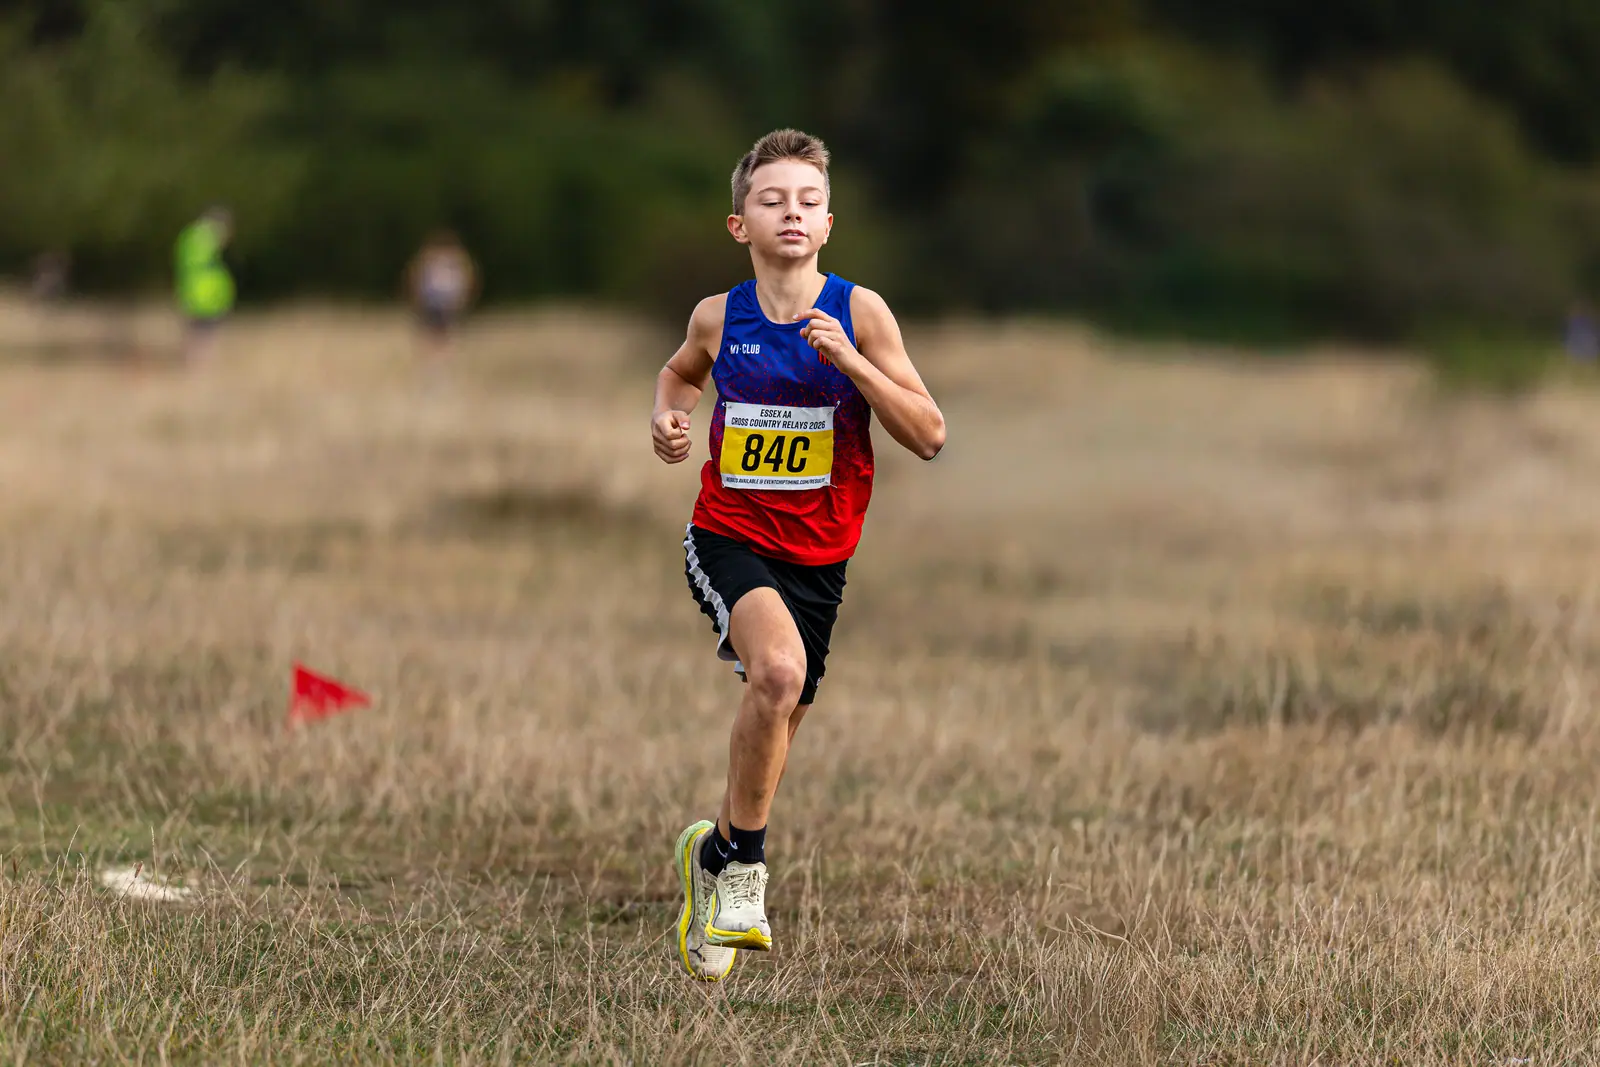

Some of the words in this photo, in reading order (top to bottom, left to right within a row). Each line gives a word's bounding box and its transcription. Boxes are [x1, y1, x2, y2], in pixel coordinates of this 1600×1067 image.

[760, 409, 781, 418] ESSEX
[783, 410, 792, 419] AA
[731, 417, 749, 427] CROSS
[749, 418, 781, 428] COUNTRY
[782, 420, 808, 429] RELAYS
[809, 420, 826, 430] 2026
[741, 433, 810, 473] 84C
